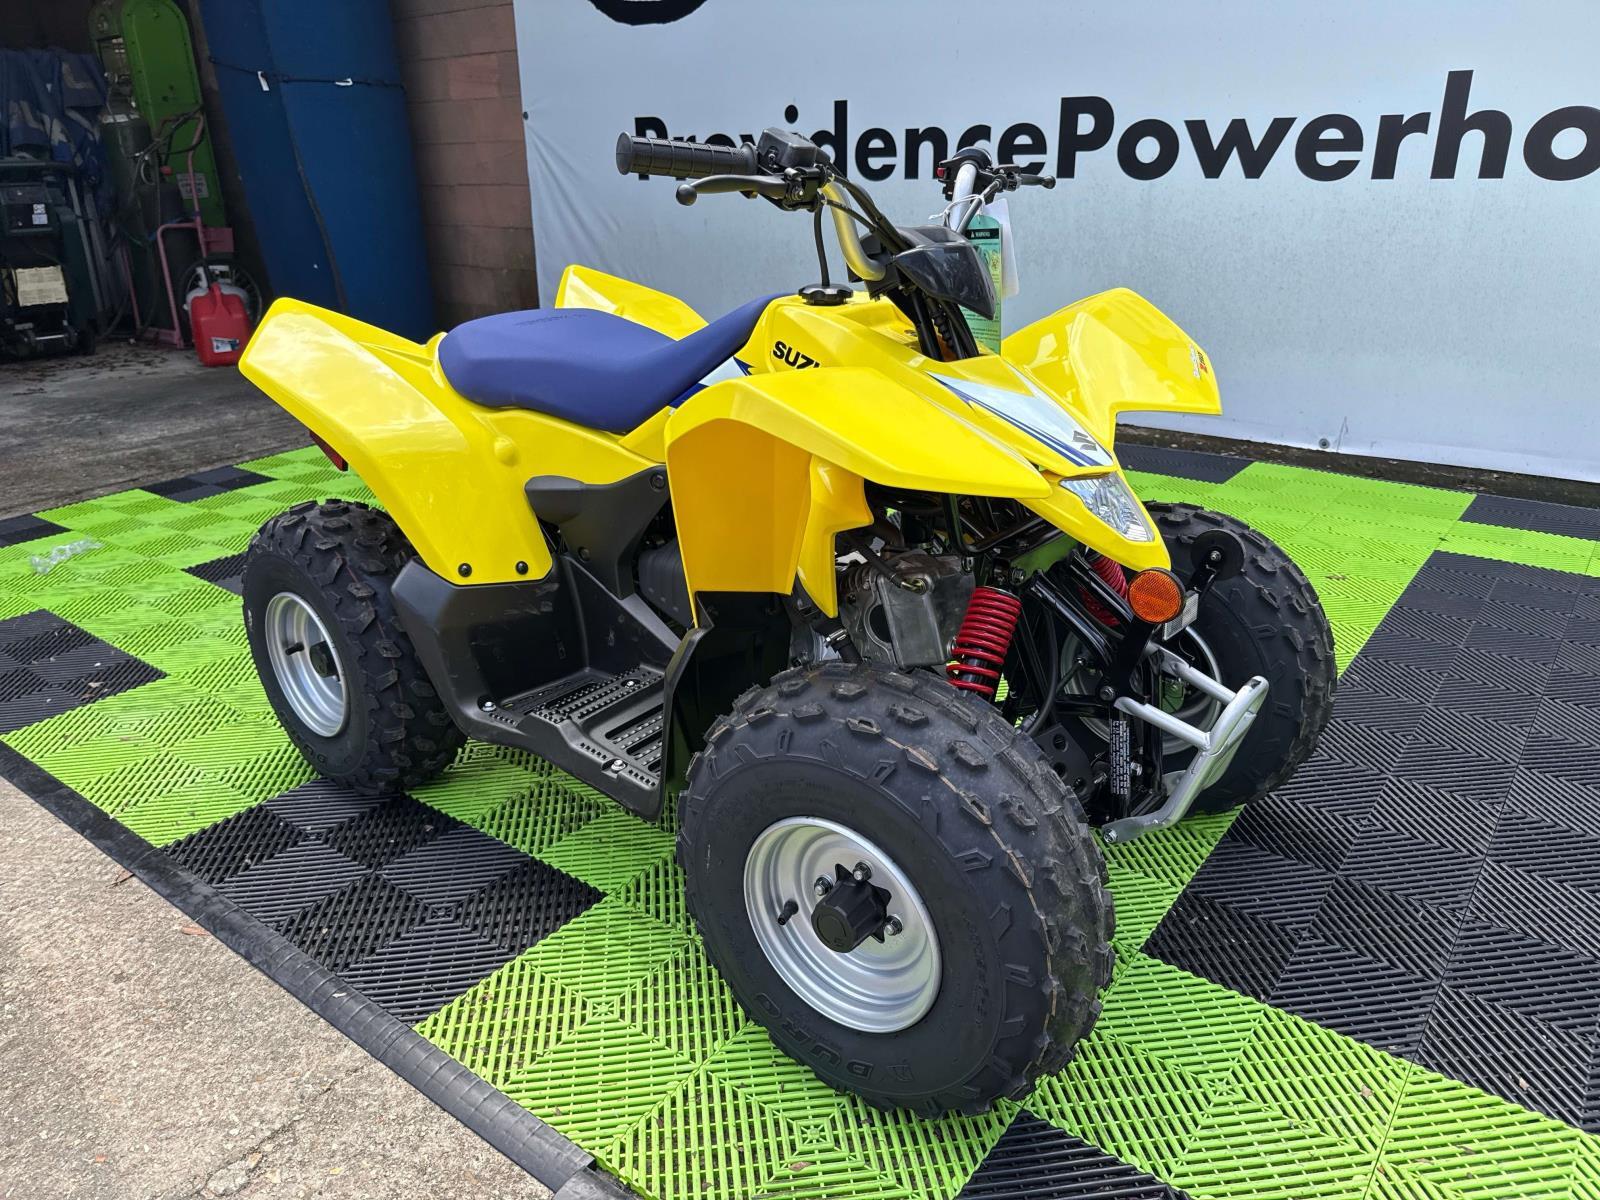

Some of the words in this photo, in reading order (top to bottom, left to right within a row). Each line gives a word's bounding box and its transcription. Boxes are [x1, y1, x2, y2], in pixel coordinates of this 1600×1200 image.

[634, 69, 1600, 182] denePowerho
[773, 340, 820, 369] SUZ
[756, 992, 874, 1080] DURO
